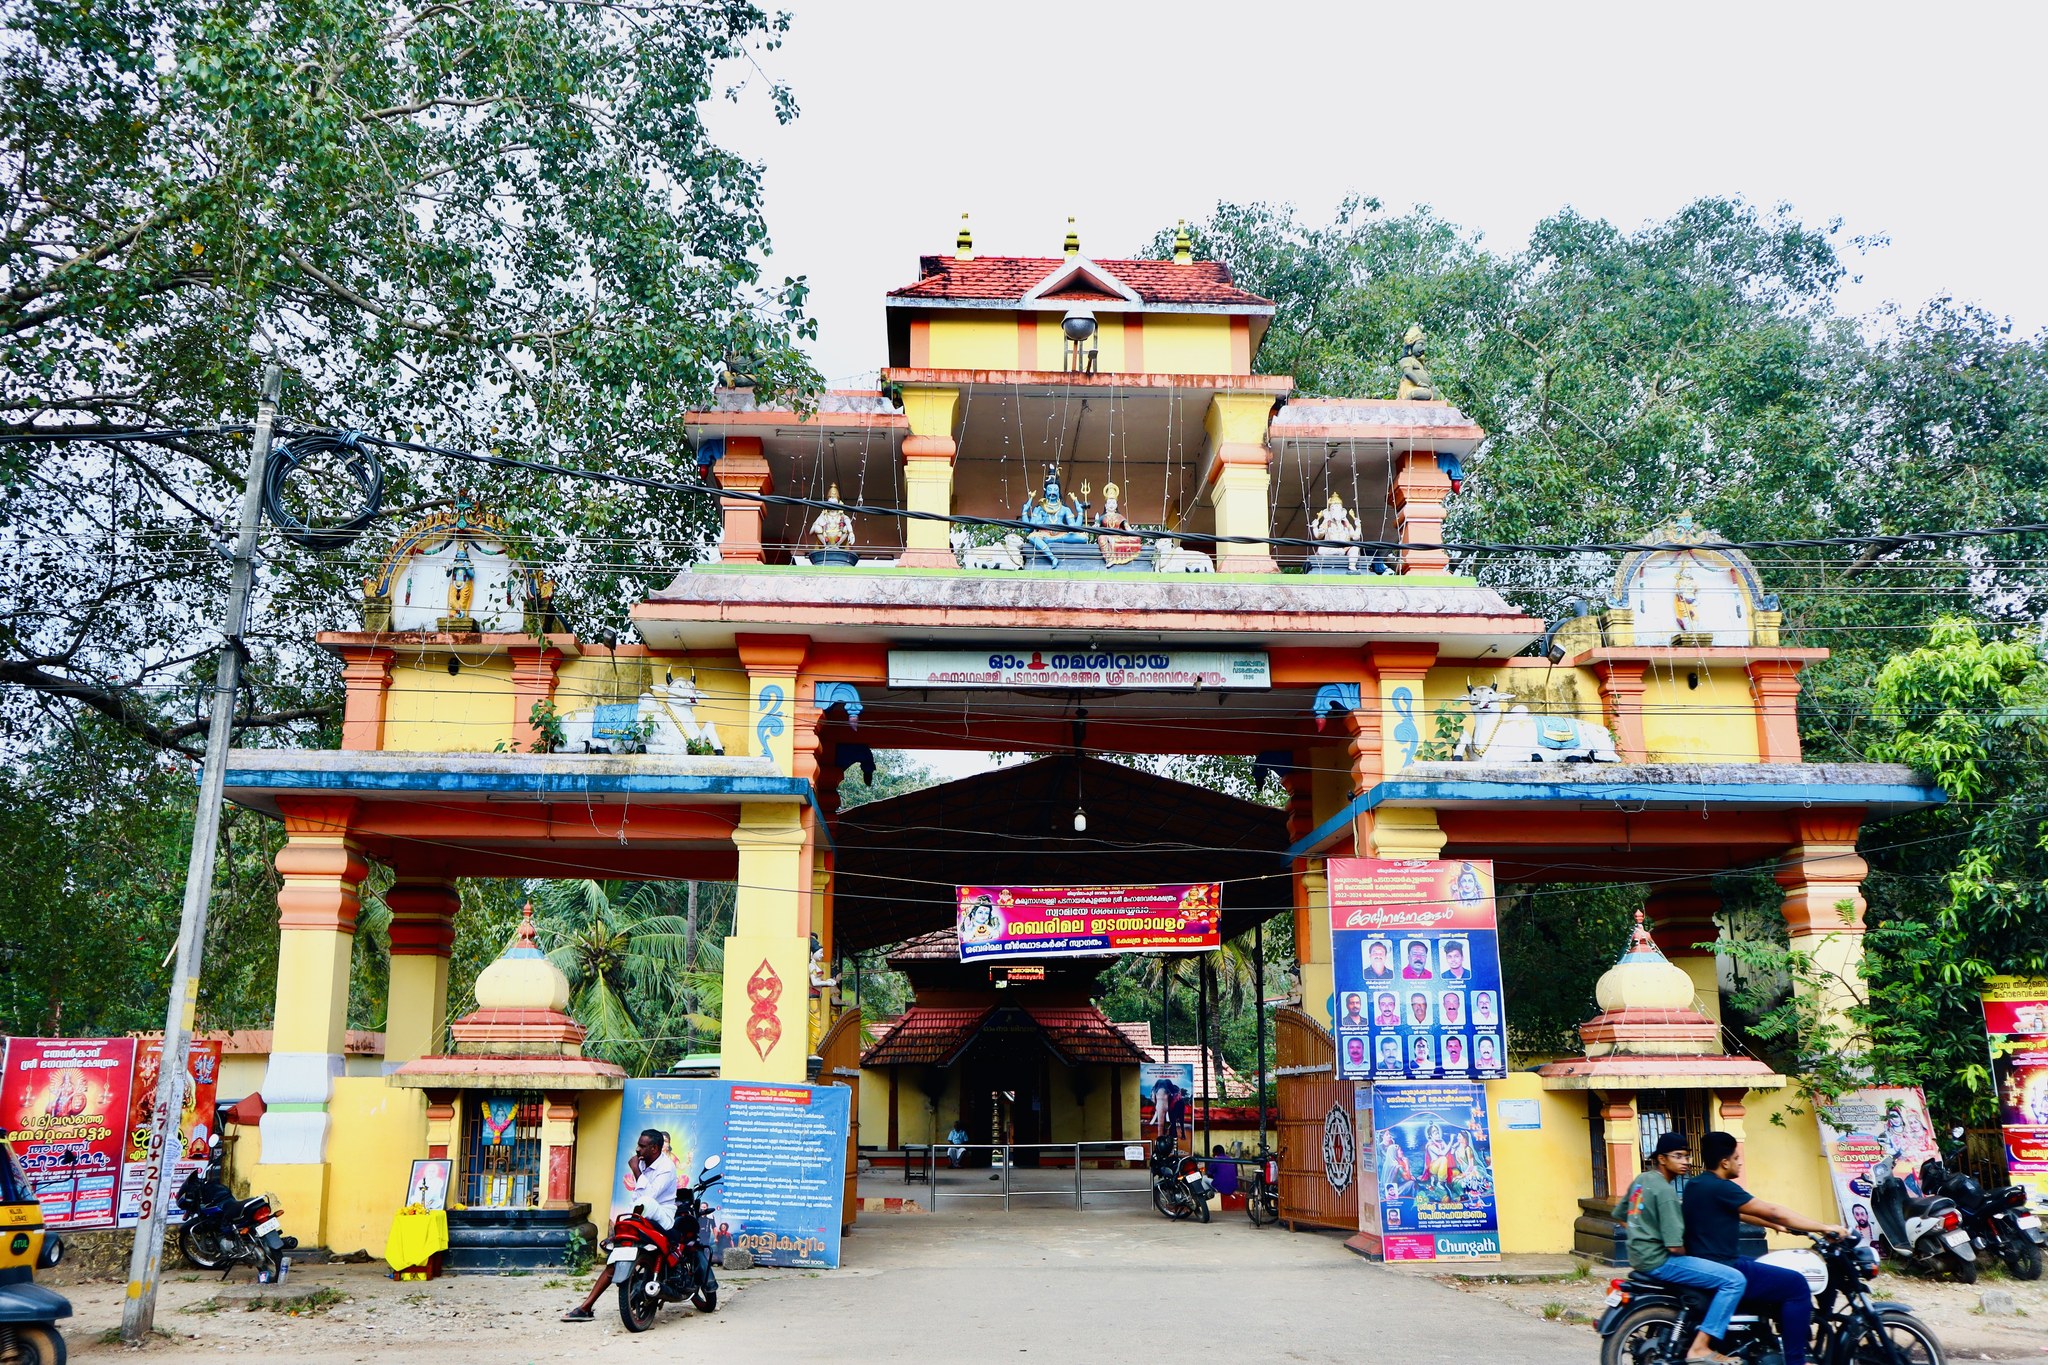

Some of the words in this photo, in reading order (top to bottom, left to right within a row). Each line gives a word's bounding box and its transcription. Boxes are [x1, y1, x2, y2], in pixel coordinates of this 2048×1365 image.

[989, 655, 1024, 669] ഓം
[1106, 669, 1124, 686] ശ്രീ
[1008, 917, 1085, 936] ശബരിമല
[1091, 917, 1186, 935] ഇടത്താവളം
[965, 943, 1003, 954] ശബരിമല
[1069, 939, 1102, 948] സ്വാഗതം
[1178, 935, 1203, 943] സമിതി
[20, 1058, 38, 1071] ശ്രീ
[1437, 1237, 1497, 1258] Chungath
